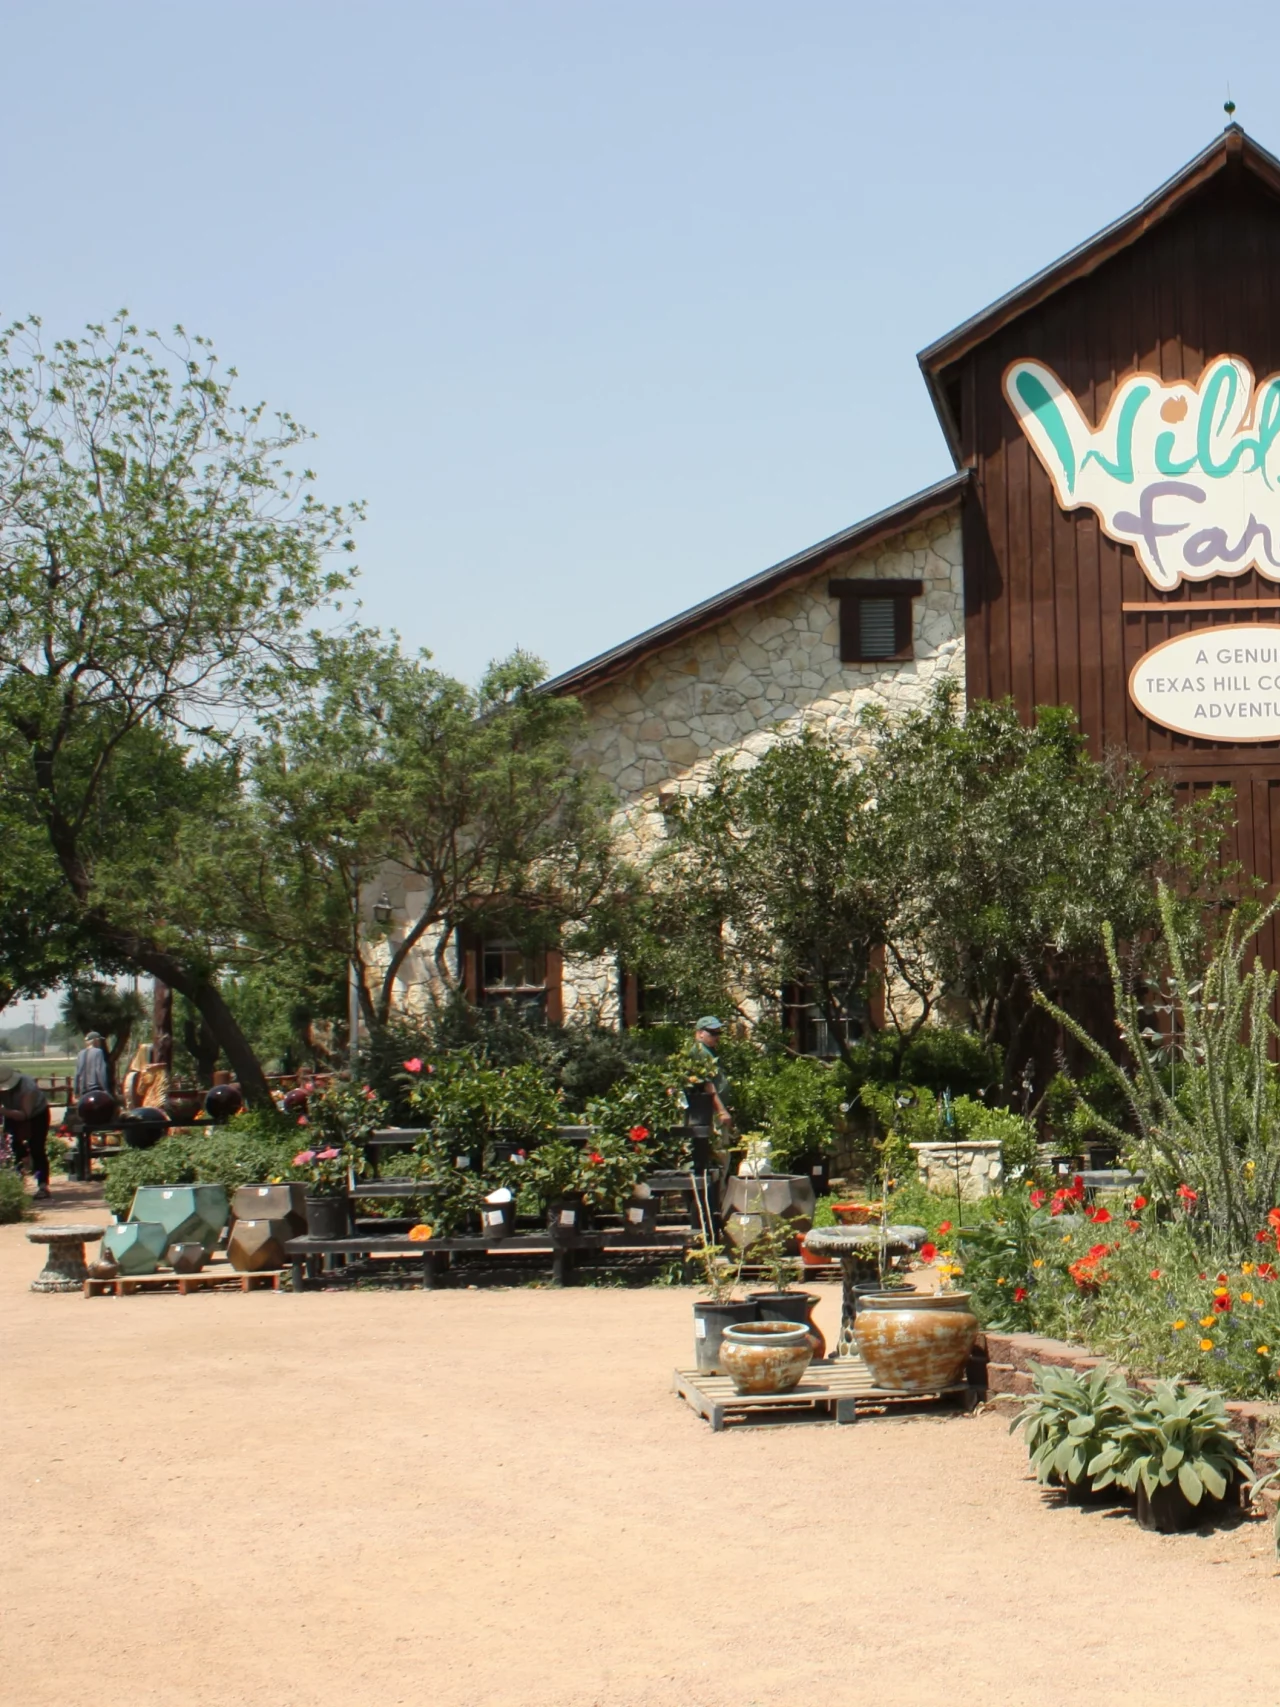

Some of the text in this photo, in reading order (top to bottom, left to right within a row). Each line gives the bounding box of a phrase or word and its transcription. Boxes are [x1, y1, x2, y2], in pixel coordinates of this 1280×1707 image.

[1195, 649, 1208, 664] A
[1146, 677, 1206, 692] TEXAS
[1213, 676, 1251, 692] HILL
